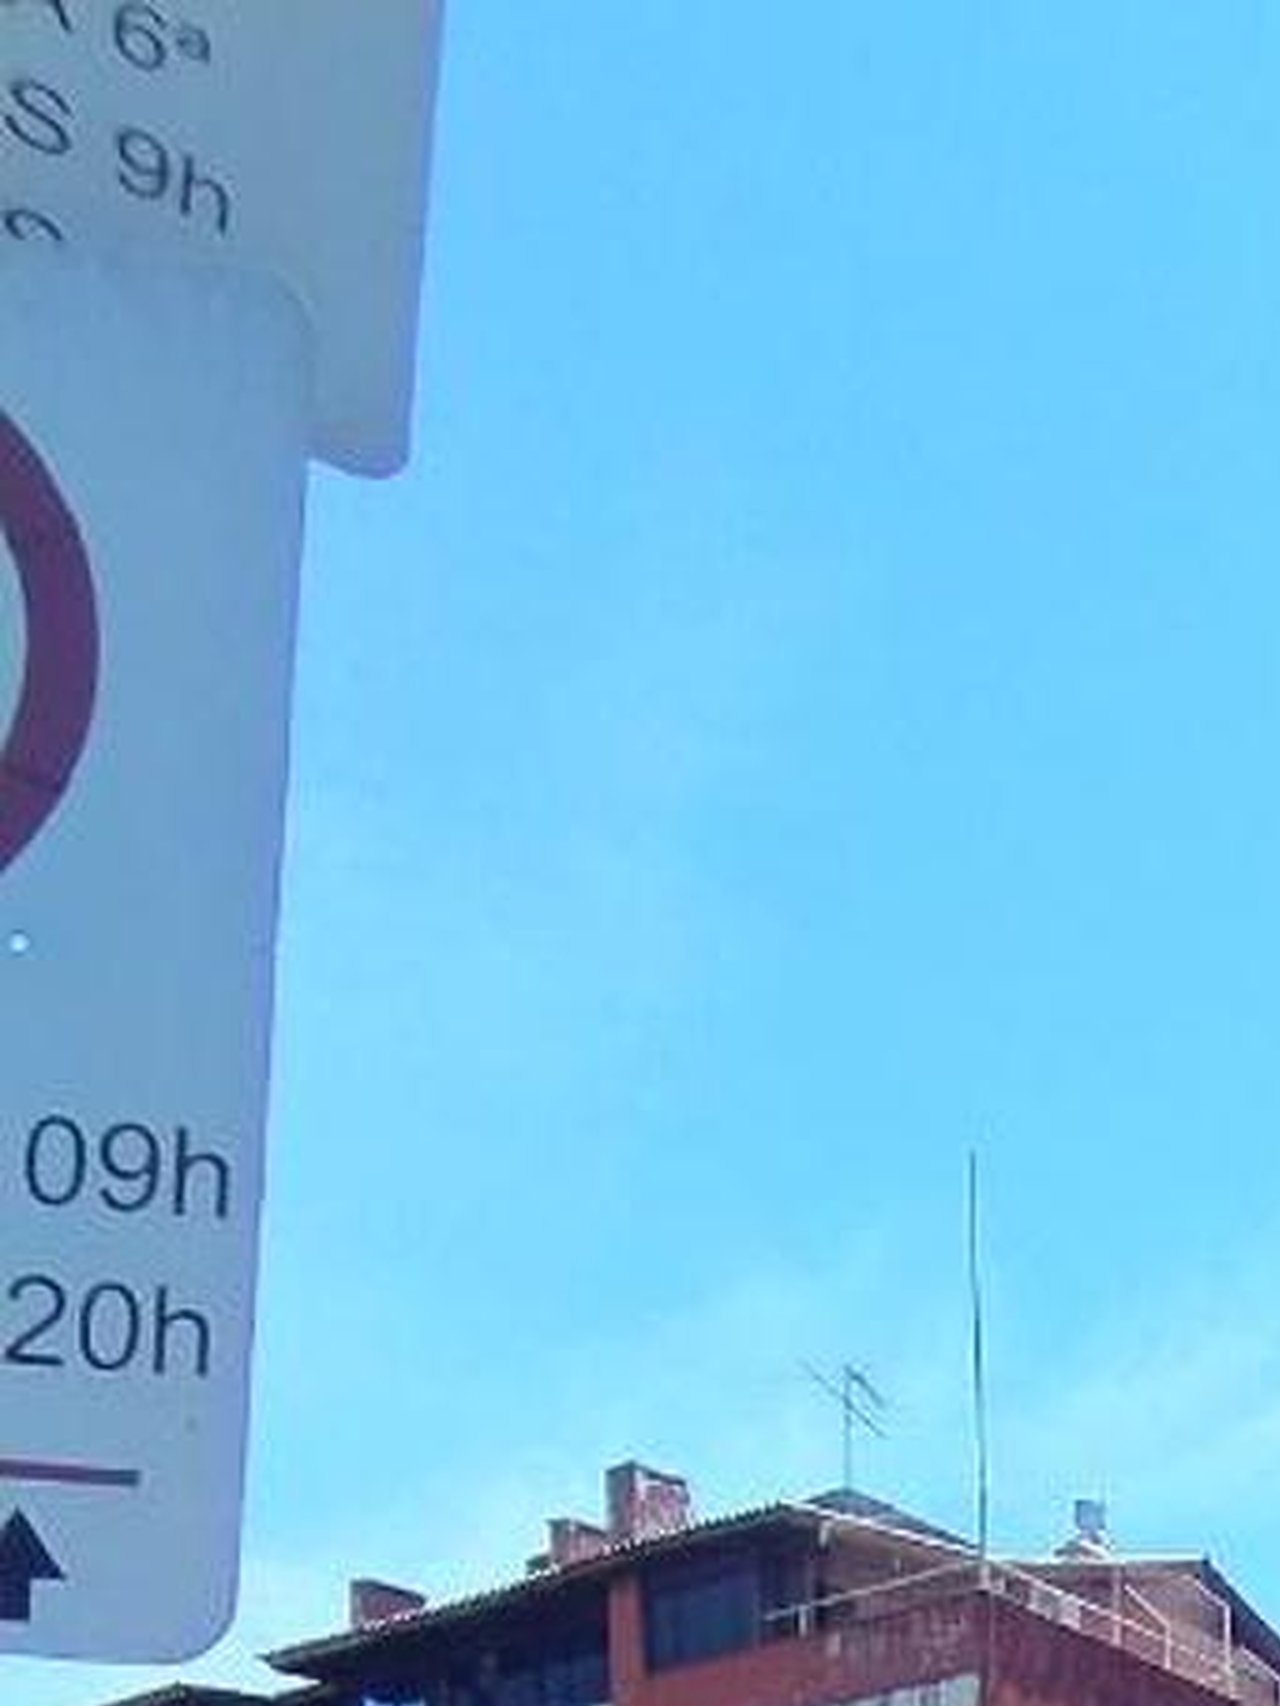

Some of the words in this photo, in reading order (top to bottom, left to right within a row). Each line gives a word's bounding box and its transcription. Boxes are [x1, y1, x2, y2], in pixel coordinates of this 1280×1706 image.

[117, 127, 229, 236] 9h
[25, 1113, 230, 1220] 09h
[3, 1274, 210, 1377] 20h
